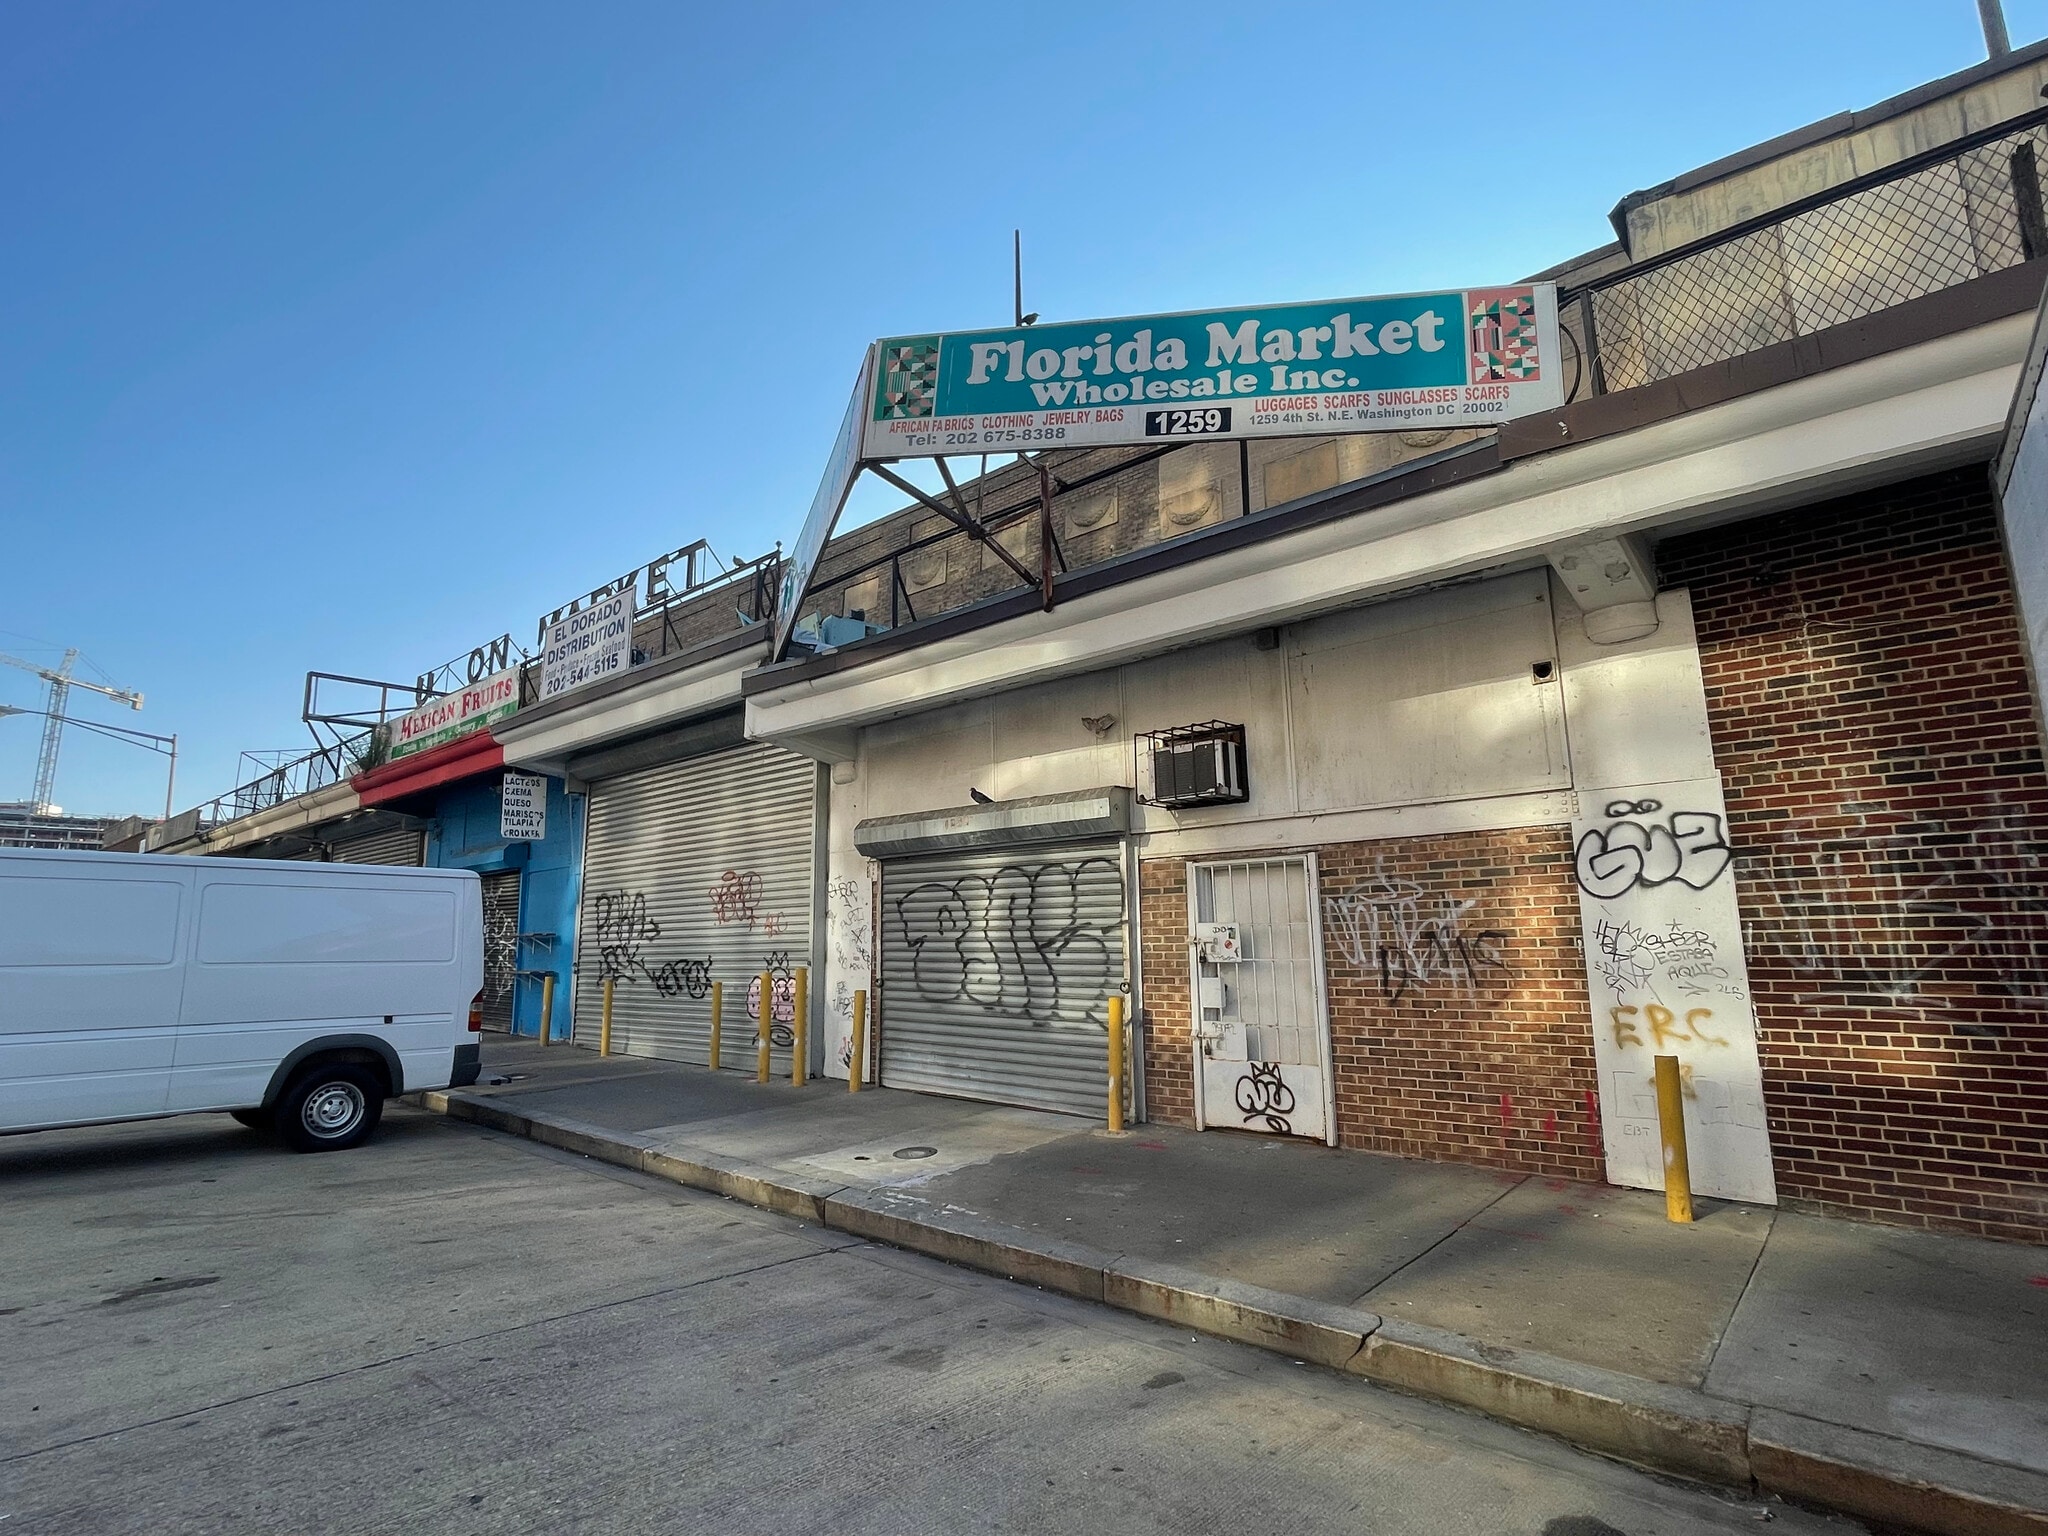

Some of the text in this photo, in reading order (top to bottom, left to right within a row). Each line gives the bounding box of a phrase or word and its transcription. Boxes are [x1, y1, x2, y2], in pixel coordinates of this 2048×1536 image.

[966, 310, 1446, 385] Florida Market
[1030, 364, 1360, 407] Wholesale Inc.
[1255, 385, 1510, 413] LUGGAGES SCARFS SUNGLASSES SCARFS
[889, 420, 930, 434] AFRICAN
[982, 413, 1034, 429] CLOTHING
[1042, 410, 1090, 426] JEWELRY
[1096, 408, 1124, 423] BAGS
[1155, 409, 1222, 434] 1259
[1249, 402, 1503, 425] 1259 4th St. N.E. Washington DC 20002
[905, 427, 1066, 447] Tel: 202 675-8388
[554, 600, 622, 643] EL DORADO
[547, 616, 626, 665] DISTRIBUTION
[400, 678, 513, 741] MEXICAN FRUITS
[504, 798, 531, 807] QUESO
[504, 818, 534, 826] TILAPIA
